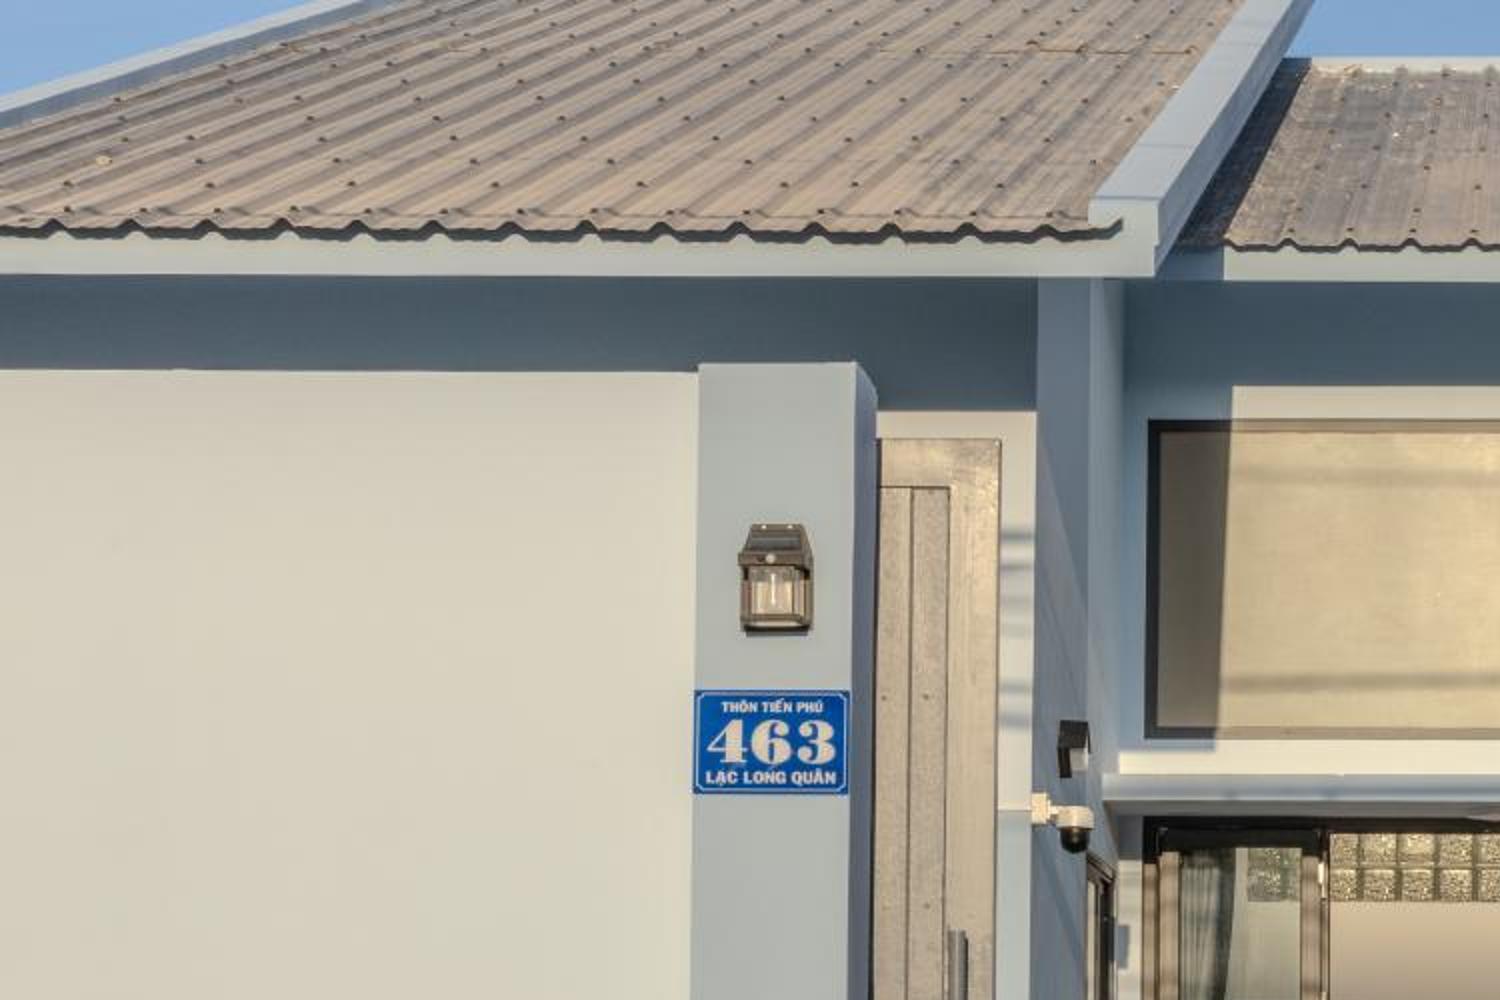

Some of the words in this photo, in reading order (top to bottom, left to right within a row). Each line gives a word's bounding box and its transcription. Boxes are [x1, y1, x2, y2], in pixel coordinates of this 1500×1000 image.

[722, 700, 757, 713] THÔN
[762, 698, 792, 713] TIẾN
[707, 719, 836, 765] 463
[706, 771, 738, 786] LẠC
[792, 769, 836, 786] QUÂN
